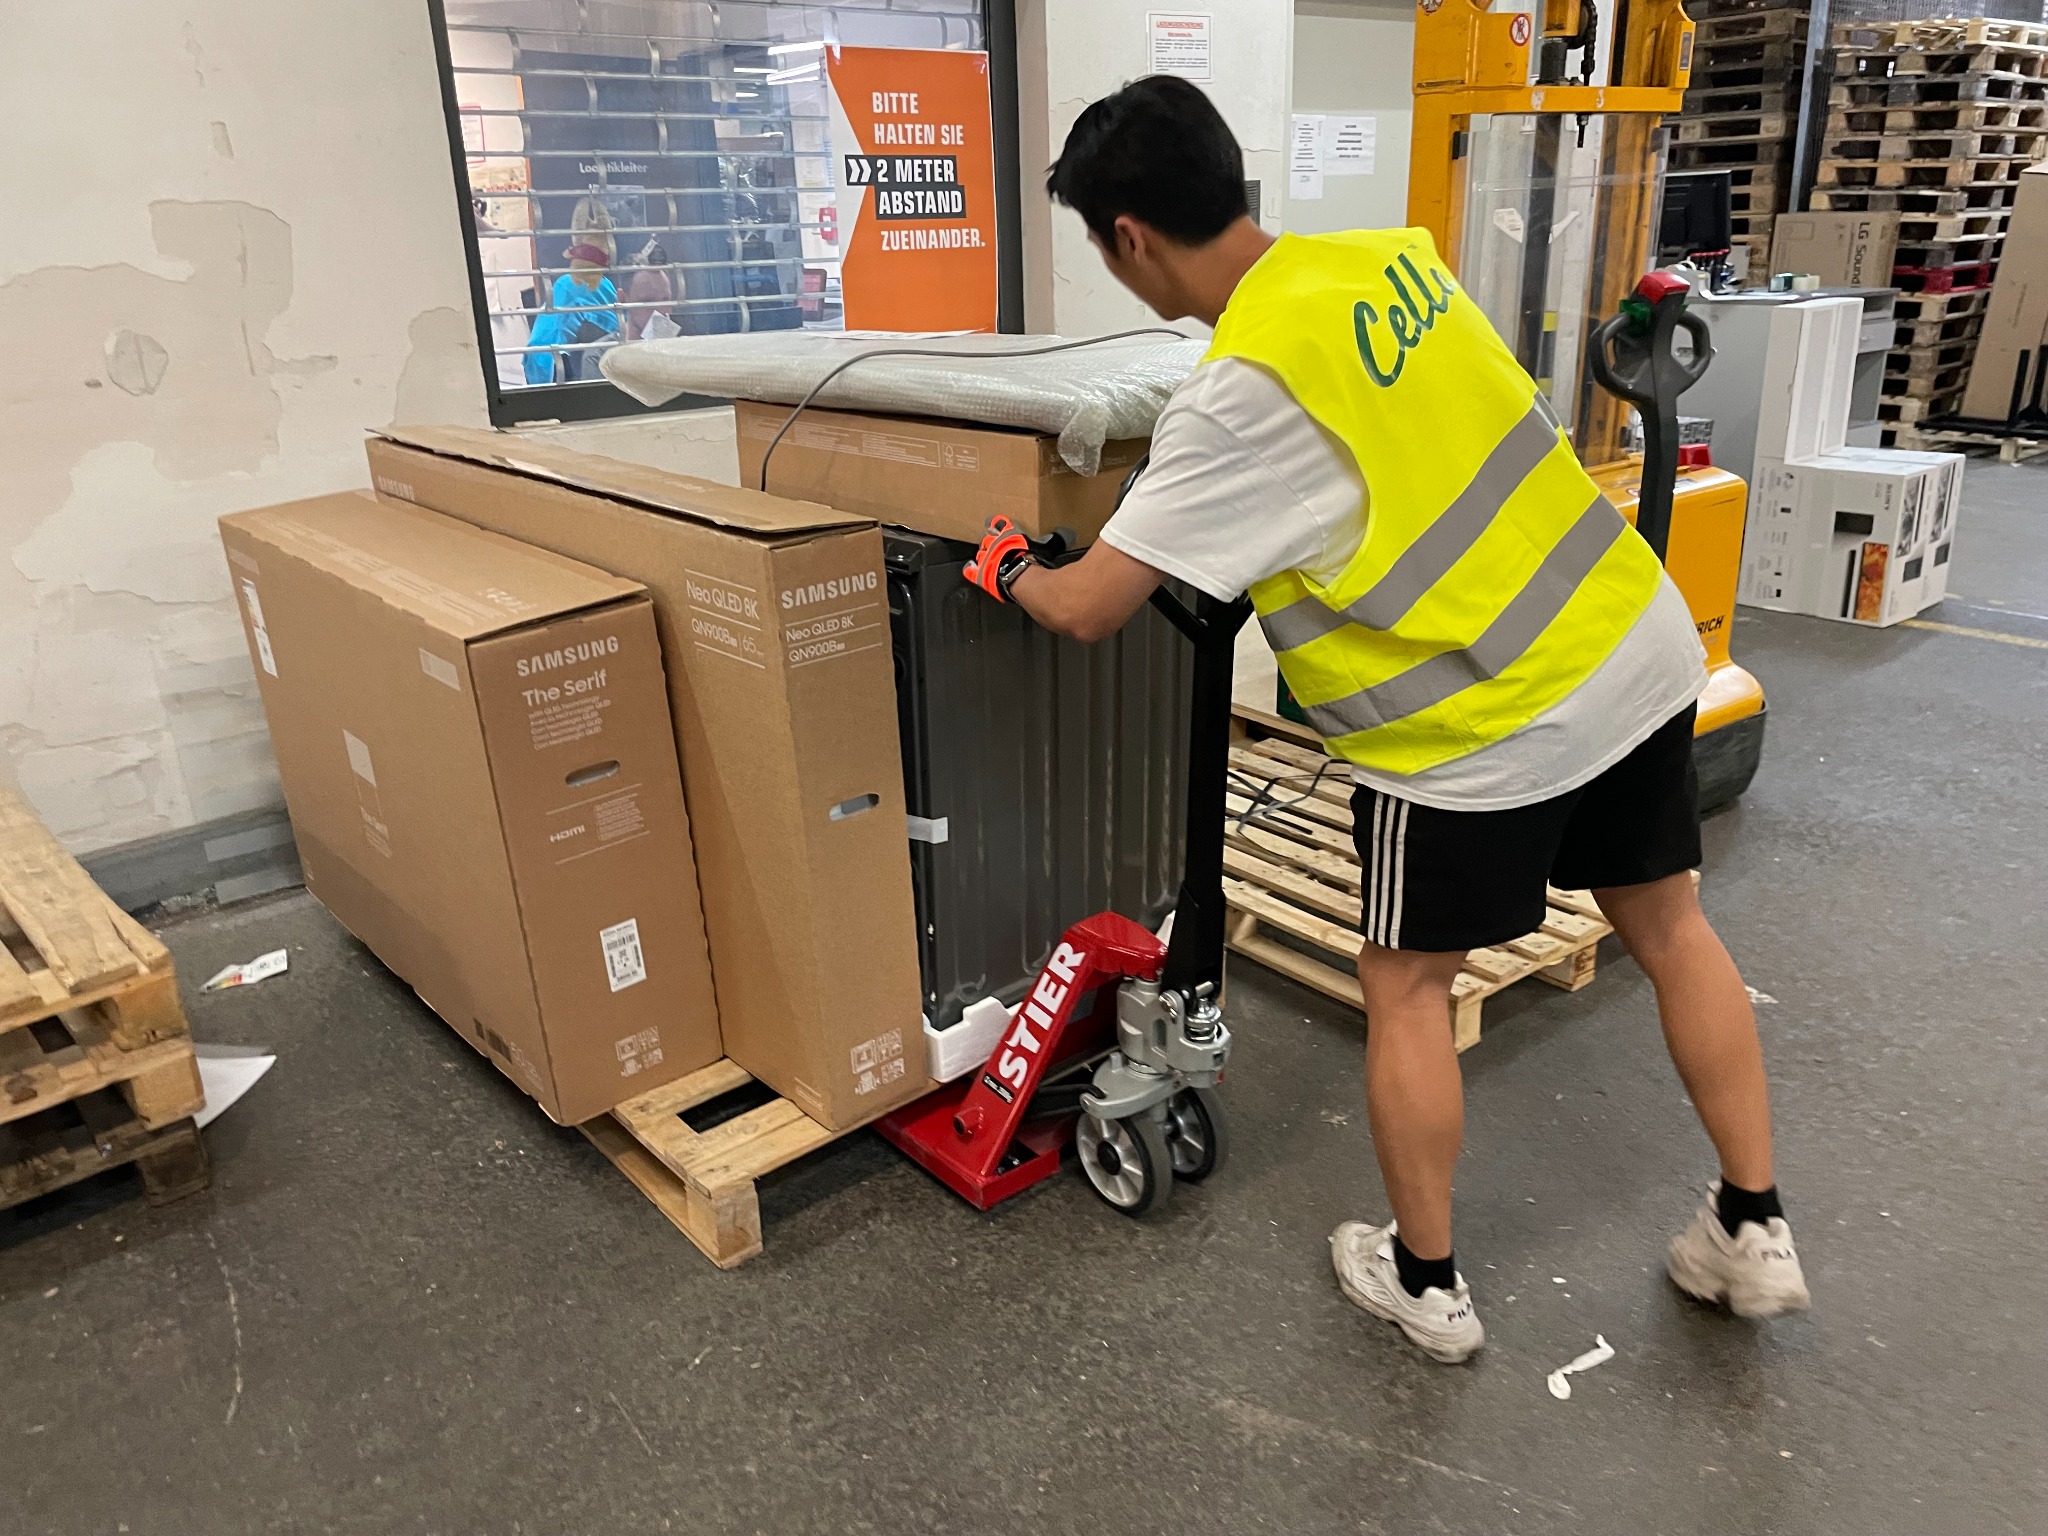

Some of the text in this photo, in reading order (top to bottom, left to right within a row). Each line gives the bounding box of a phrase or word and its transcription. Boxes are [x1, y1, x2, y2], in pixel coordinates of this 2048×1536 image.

[872, 91, 919, 114] BITTE
[874, 123, 965, 146] HALTEN SIE
[578, 161, 649, 173] Lotikleiter
[876, 159, 955, 183] 2 METER
[878, 190, 963, 215] ABSTAND
[881, 228, 986, 251] ZUEINANDER.
[1858, 221, 1871, 240] LG
[377, 475, 416, 501] SAMSUNG
[686, 579, 760, 620] Neo QLED 8K
[781, 571, 878, 609] SAMSUNG
[786, 615, 855, 642] Neo QLED 8K
[516, 635, 619, 677] SAMSUNG
[522, 669, 608, 707] The Serif
[549, 824, 586, 843] HDMI
[998, 942, 1086, 1089] STIER
